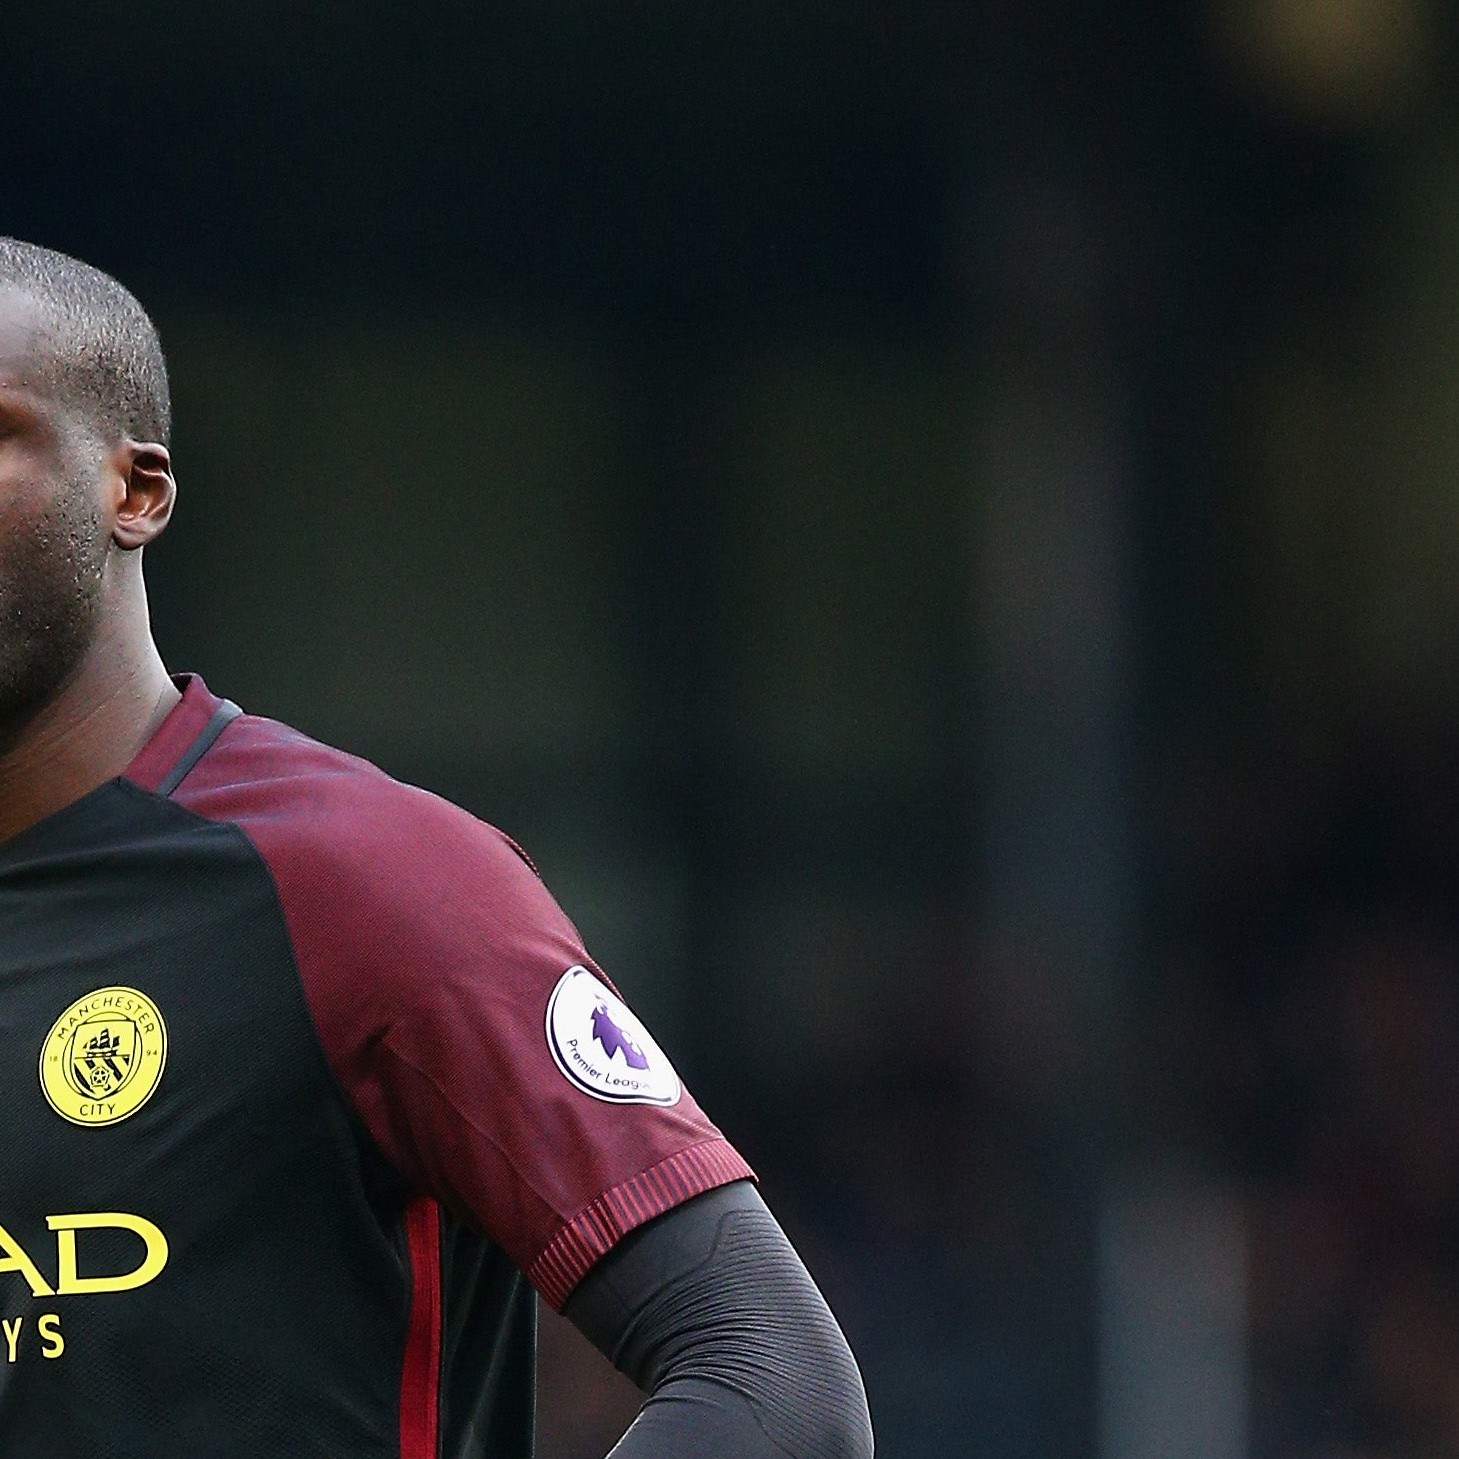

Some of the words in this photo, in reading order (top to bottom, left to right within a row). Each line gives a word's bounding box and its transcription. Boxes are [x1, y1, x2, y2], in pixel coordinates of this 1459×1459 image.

[57, 996, 155, 1040] MANCHESTER
[567, 1038, 603, 1079] Premier
[604, 1072, 650, 1090] Leag
[79, 1103, 116, 1116] CITY
